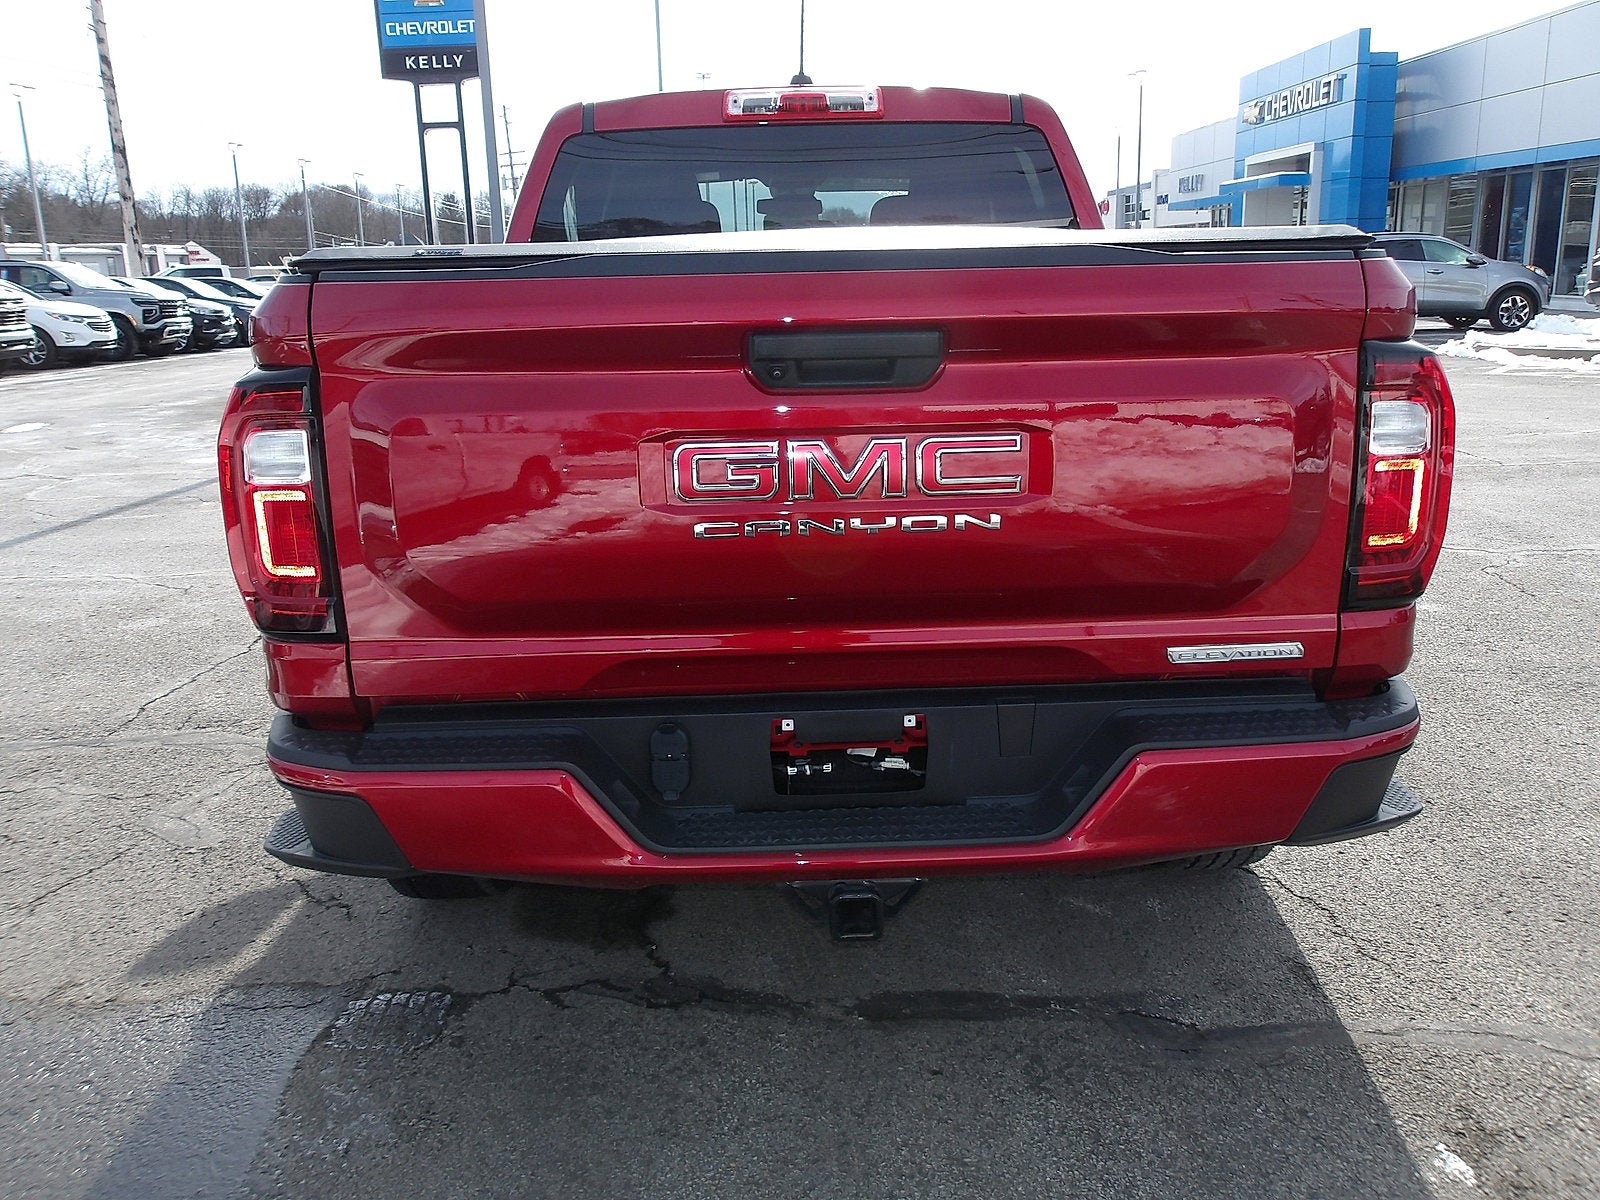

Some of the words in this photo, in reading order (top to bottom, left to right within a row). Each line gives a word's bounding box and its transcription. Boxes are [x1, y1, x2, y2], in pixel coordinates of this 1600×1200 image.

[385, 19, 476, 36] CHEVROLET
[405, 54, 464, 69] KELLY
[1264, 73, 1344, 121] CHEVROLET
[1178, 174, 1204, 194] KELLY
[672, 433, 1022, 502] GMC
[693, 512, 1002, 539] CANYON
[1177, 647, 1295, 662] ELEVATION
